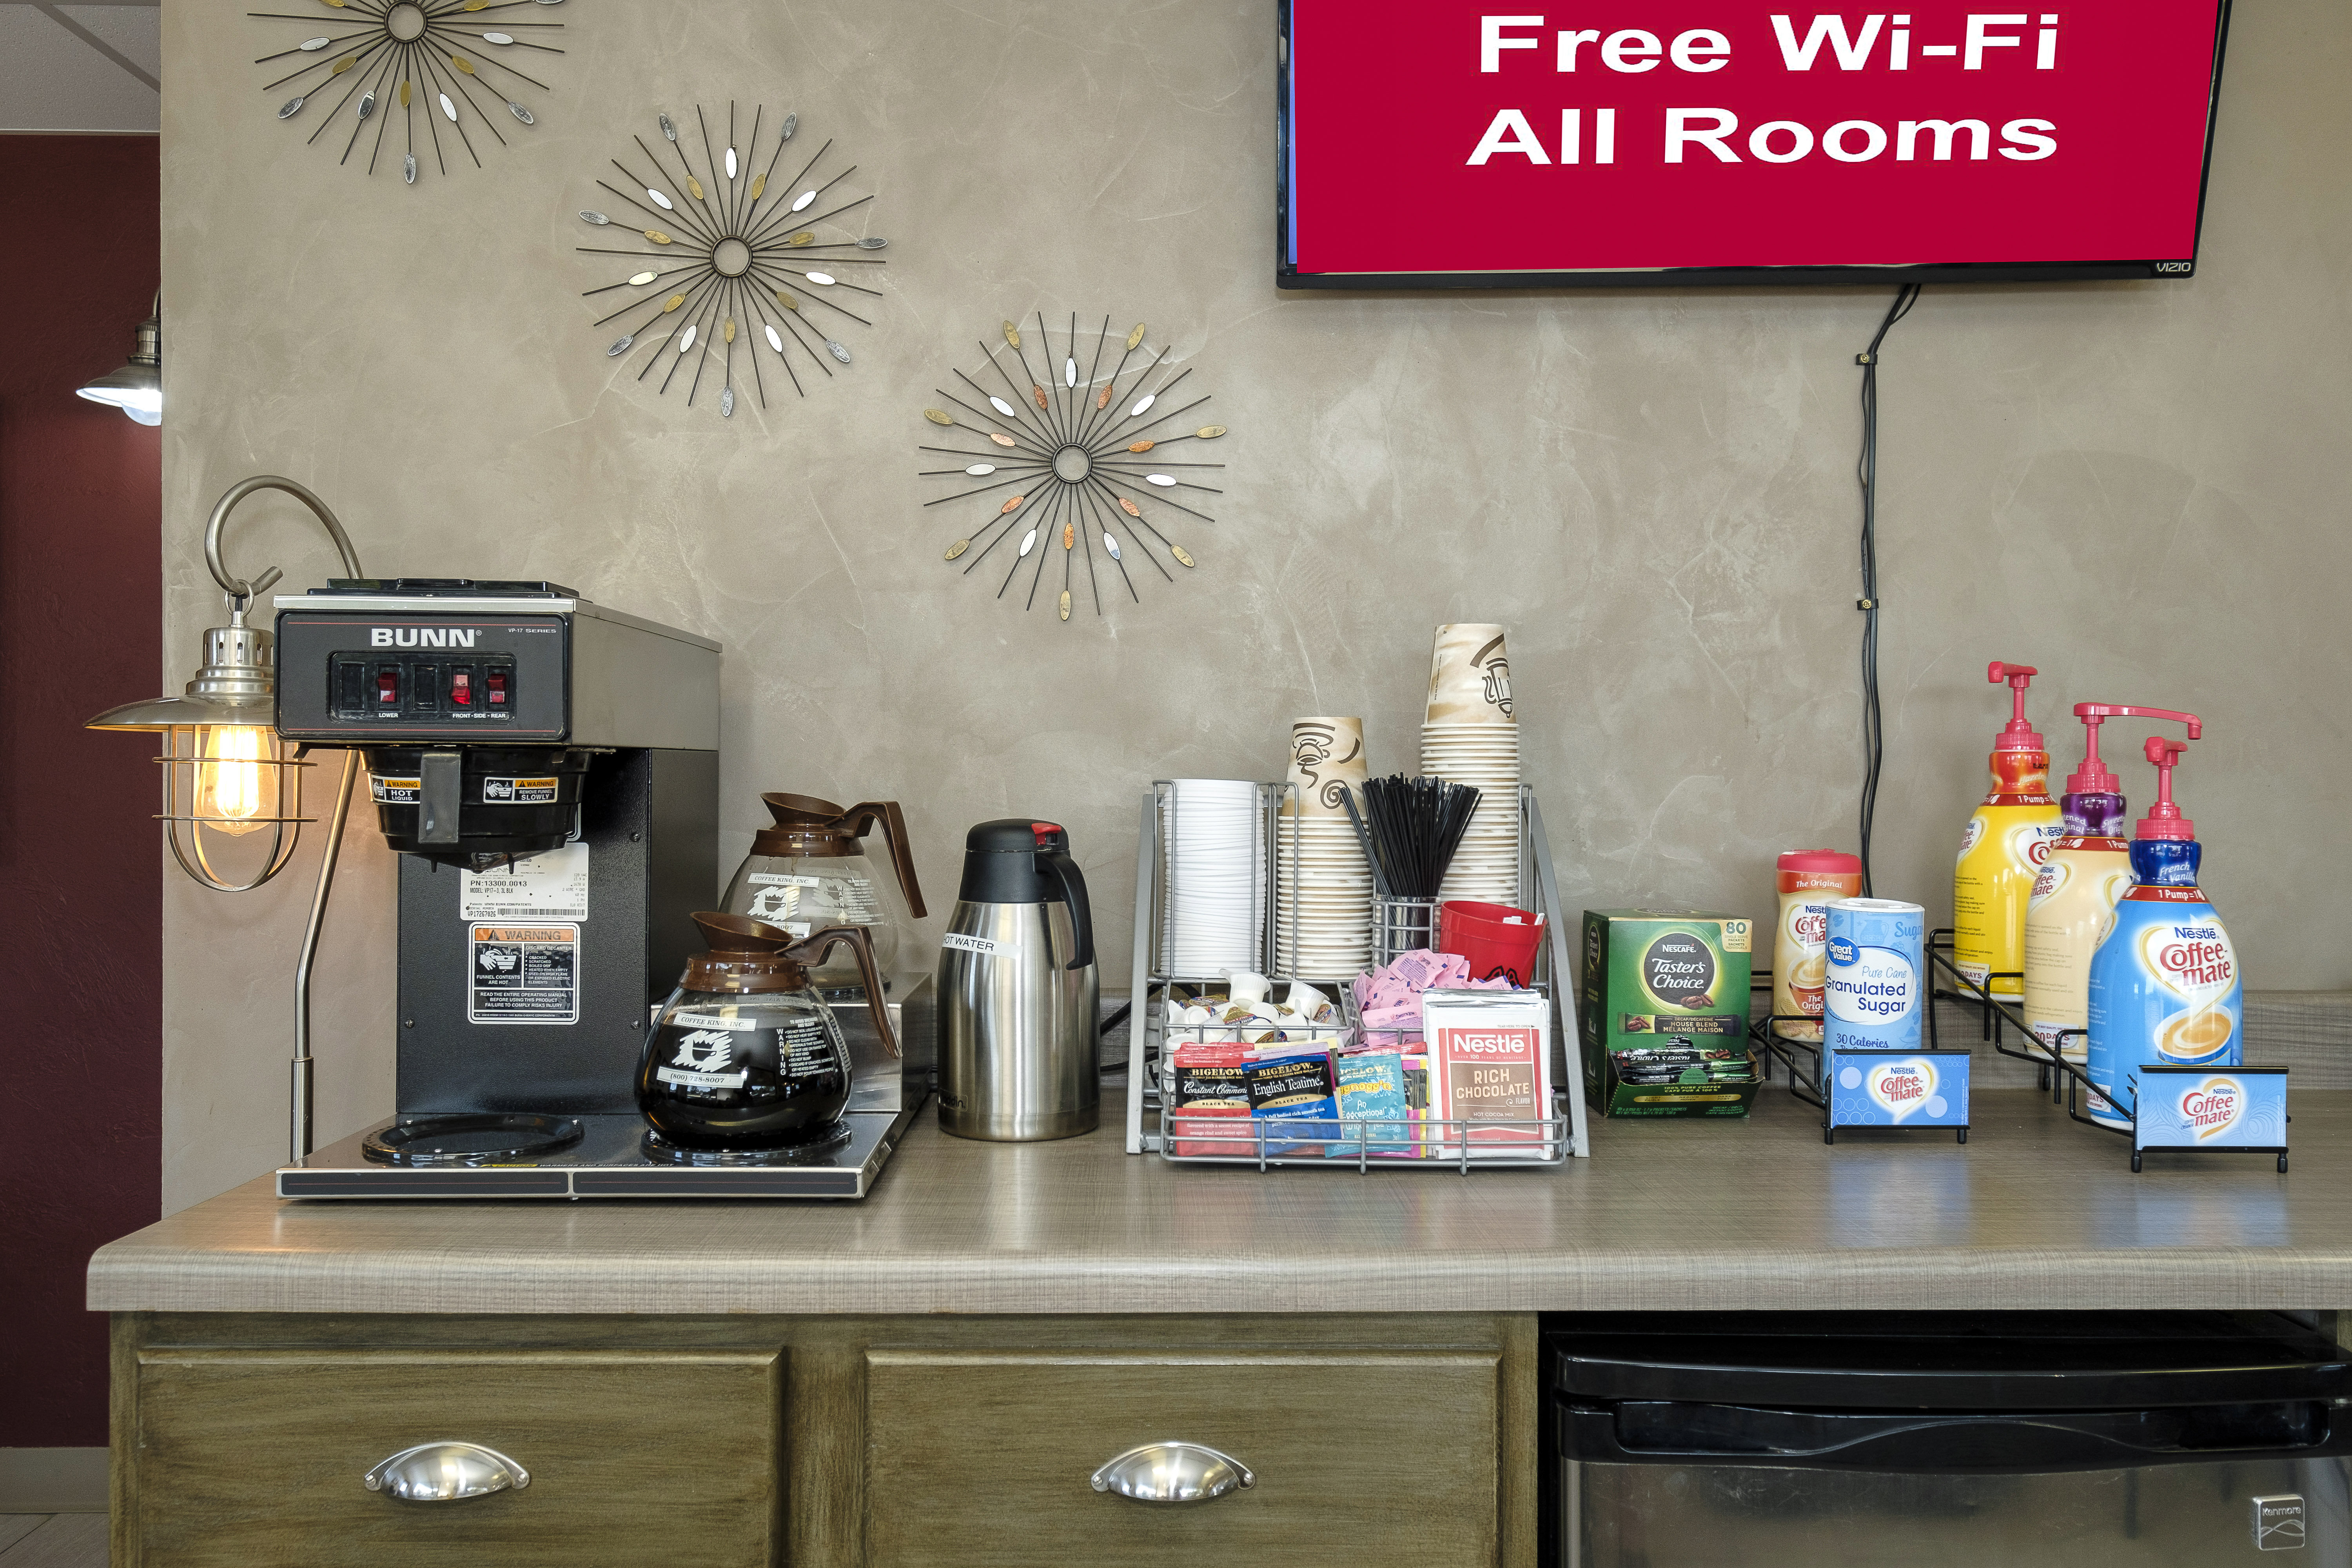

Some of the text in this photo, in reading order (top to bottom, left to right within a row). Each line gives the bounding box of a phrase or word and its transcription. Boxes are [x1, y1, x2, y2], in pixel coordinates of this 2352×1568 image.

[1481, 13, 2058, 73] Free Wi-Fi
[1465, 107, 2057, 165] All Rooms
[2157, 262, 2191, 272] VIZIO
[371, 628, 475, 647] BUNN
[2020, 771, 2047, 784] Hazelnu
[2063, 814, 2087, 826] tened
[2036, 827, 2065, 837] Nestl
[2160, 862, 2190, 877] French
[1811, 880, 1842, 889] Original
[2169, 872, 2196, 883] Vanilla
[1806, 905, 1826, 914] Nestl
[1726, 922, 1746, 934] 80
[1795, 915, 1826, 934] Coffe
[1894, 921, 1923, 940] Suga
[505, 931, 561, 940] WARNING
[1806, 930, 1826, 944] ma
[2174, 927, 2216, 939] Nestlé
[956, 937, 994, 951] WATER
[1829, 941, 1853, 955] Great
[1833, 951, 1853, 962] Value
[1651, 958, 1706, 973] Taster's
[1862, 965, 1907, 978] Pure Cane
[2182, 961, 2231, 986] mate
[1653, 974, 1704, 989] Choice
[1826, 975, 1906, 996] Granulated
[1802, 1000, 1824, 1012] Origi
[1858, 997, 1906, 1016] Sugar
[681, 1016, 706, 1025] COFFEE
[1454, 1034, 1525, 1054] Nestlé
[1836, 1033, 1890, 1048] 30 Calories
[1258, 1062, 1311, 1077] BIGELOW
[1474, 1068, 1510, 1085] RICH
[670, 1073, 688, 1081] (800)
[1216, 1083, 1247, 1094] Commen
[1253, 1076, 1321, 1096] English Teatime
[1340, 1080, 1392, 1095] ggnogg'n
[1456, 1082, 1530, 1100] CHOCOLATE
[1891, 1086, 1923, 1102] mate
[1357, 1100, 1367, 1111] An
[2183, 1092, 2234, 1116] Coffee
[2195, 1110, 2231, 1127] mate
[2262, 1506, 2301, 1516] Kenmore
